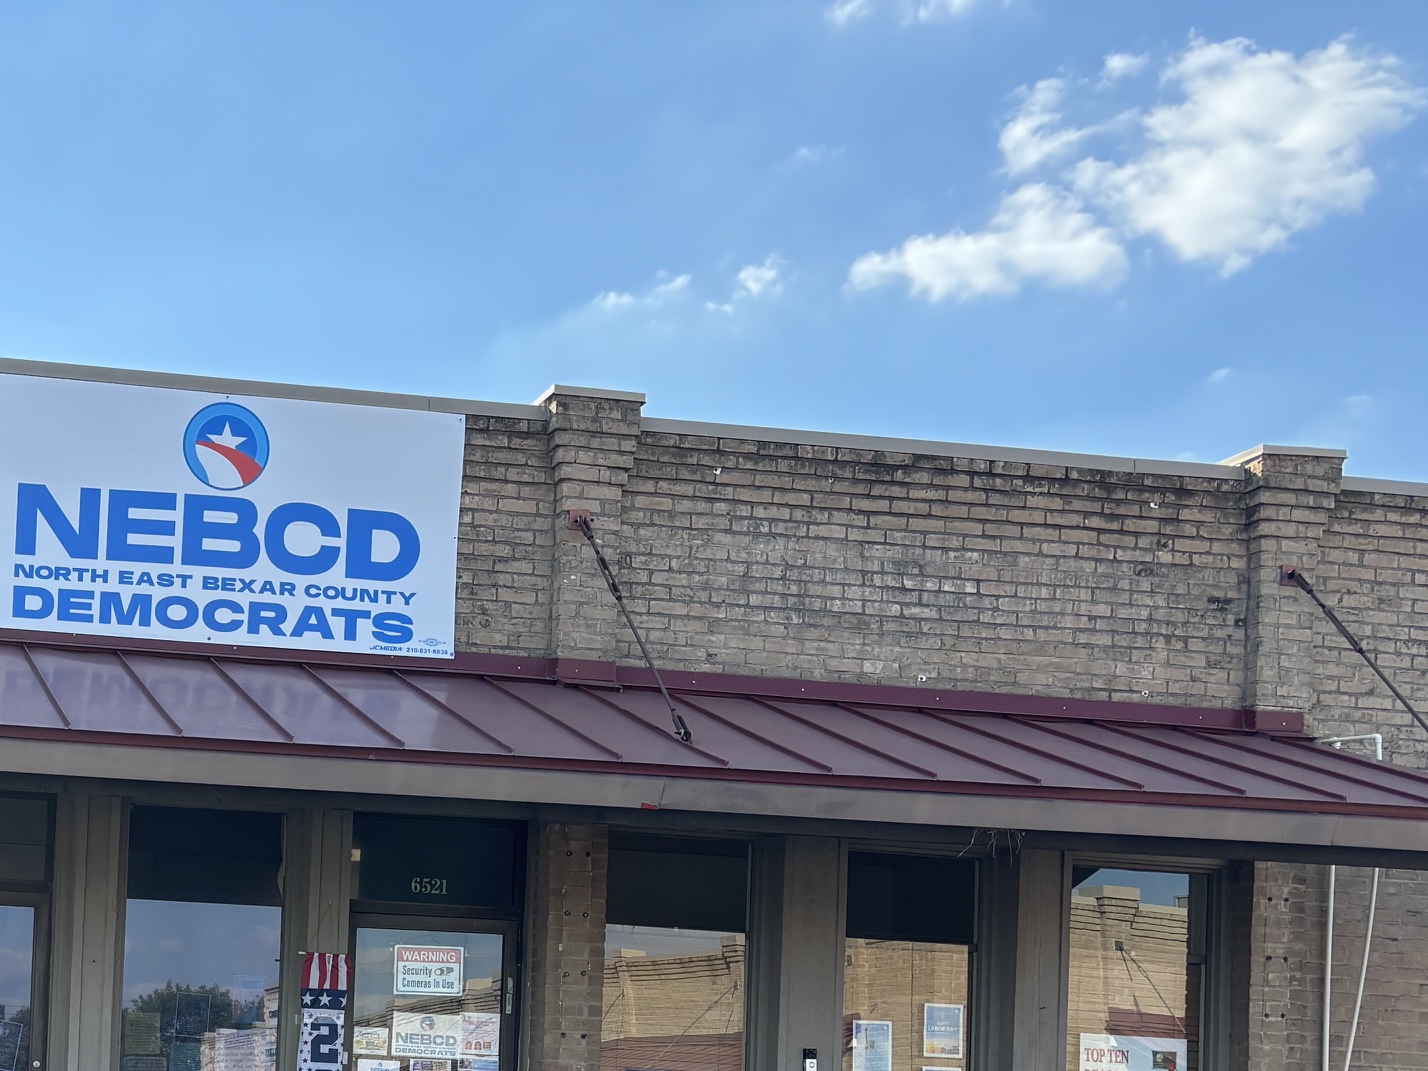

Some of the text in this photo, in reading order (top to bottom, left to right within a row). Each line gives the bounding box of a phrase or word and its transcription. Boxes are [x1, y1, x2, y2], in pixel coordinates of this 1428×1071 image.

[15, 483, 421, 582] NEBCD
[14, 564, 417, 606] NORTH EAST BEXAR COUNTY
[12, 585, 414, 644] DEMOCRATS
[411, 877, 448, 895] 6521
[402, 950, 456, 963] WARNING
[402, 965, 433, 978] Security
[402, 978, 455, 989] Cameras In Use
[395, 1032, 457, 1047] NEBCD
[395, 1048, 457, 1057] DEMOCRATS
[1084, 1048, 1129, 1064] TOP TEN
